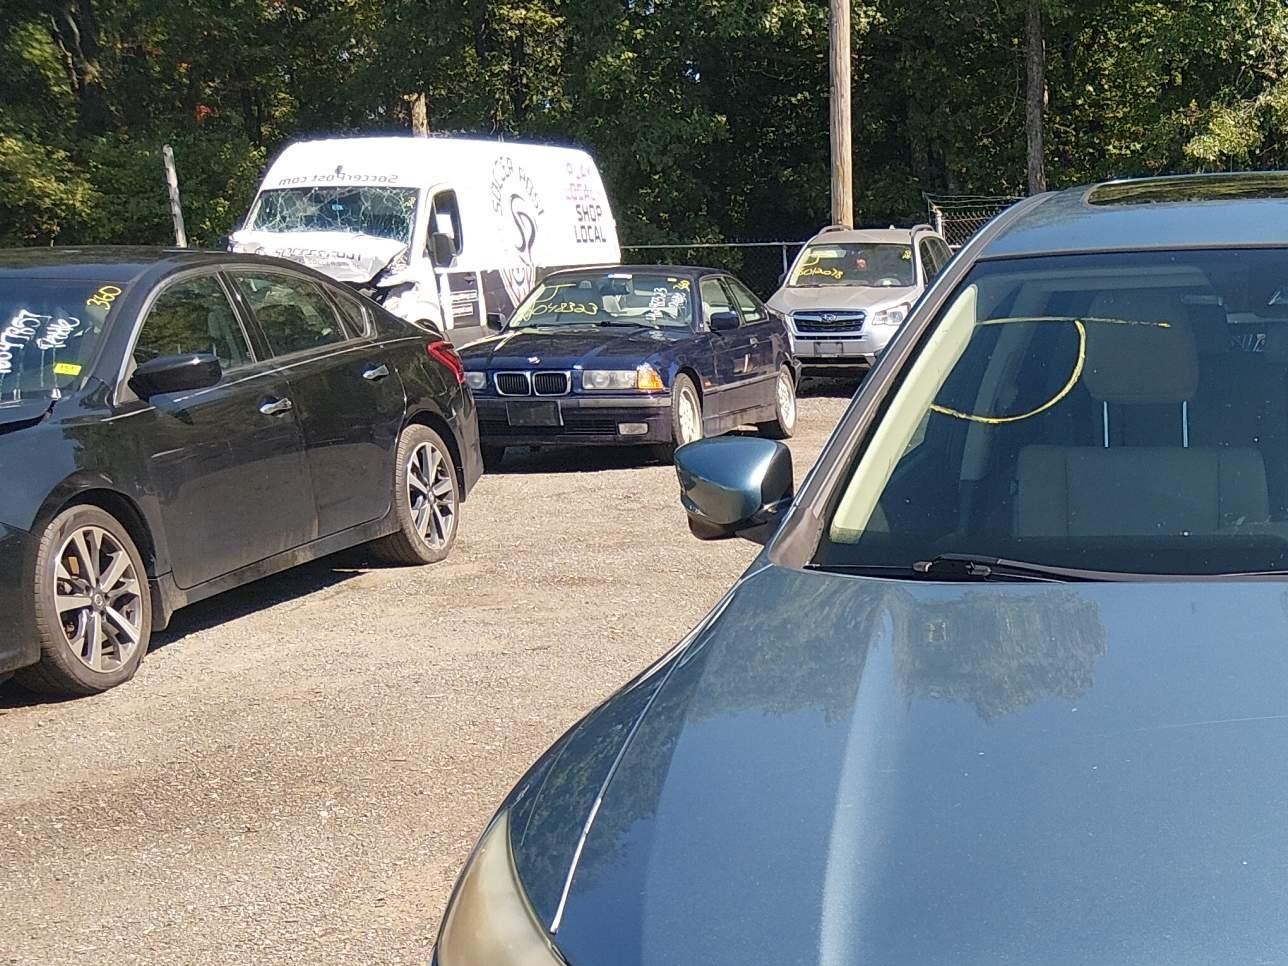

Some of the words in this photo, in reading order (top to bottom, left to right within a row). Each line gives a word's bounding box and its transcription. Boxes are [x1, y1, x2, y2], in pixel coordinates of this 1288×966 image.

[575, 203, 603, 222] SHOP
[574, 224, 607, 243] LOCAL
[86, 285, 122, 310] 360
